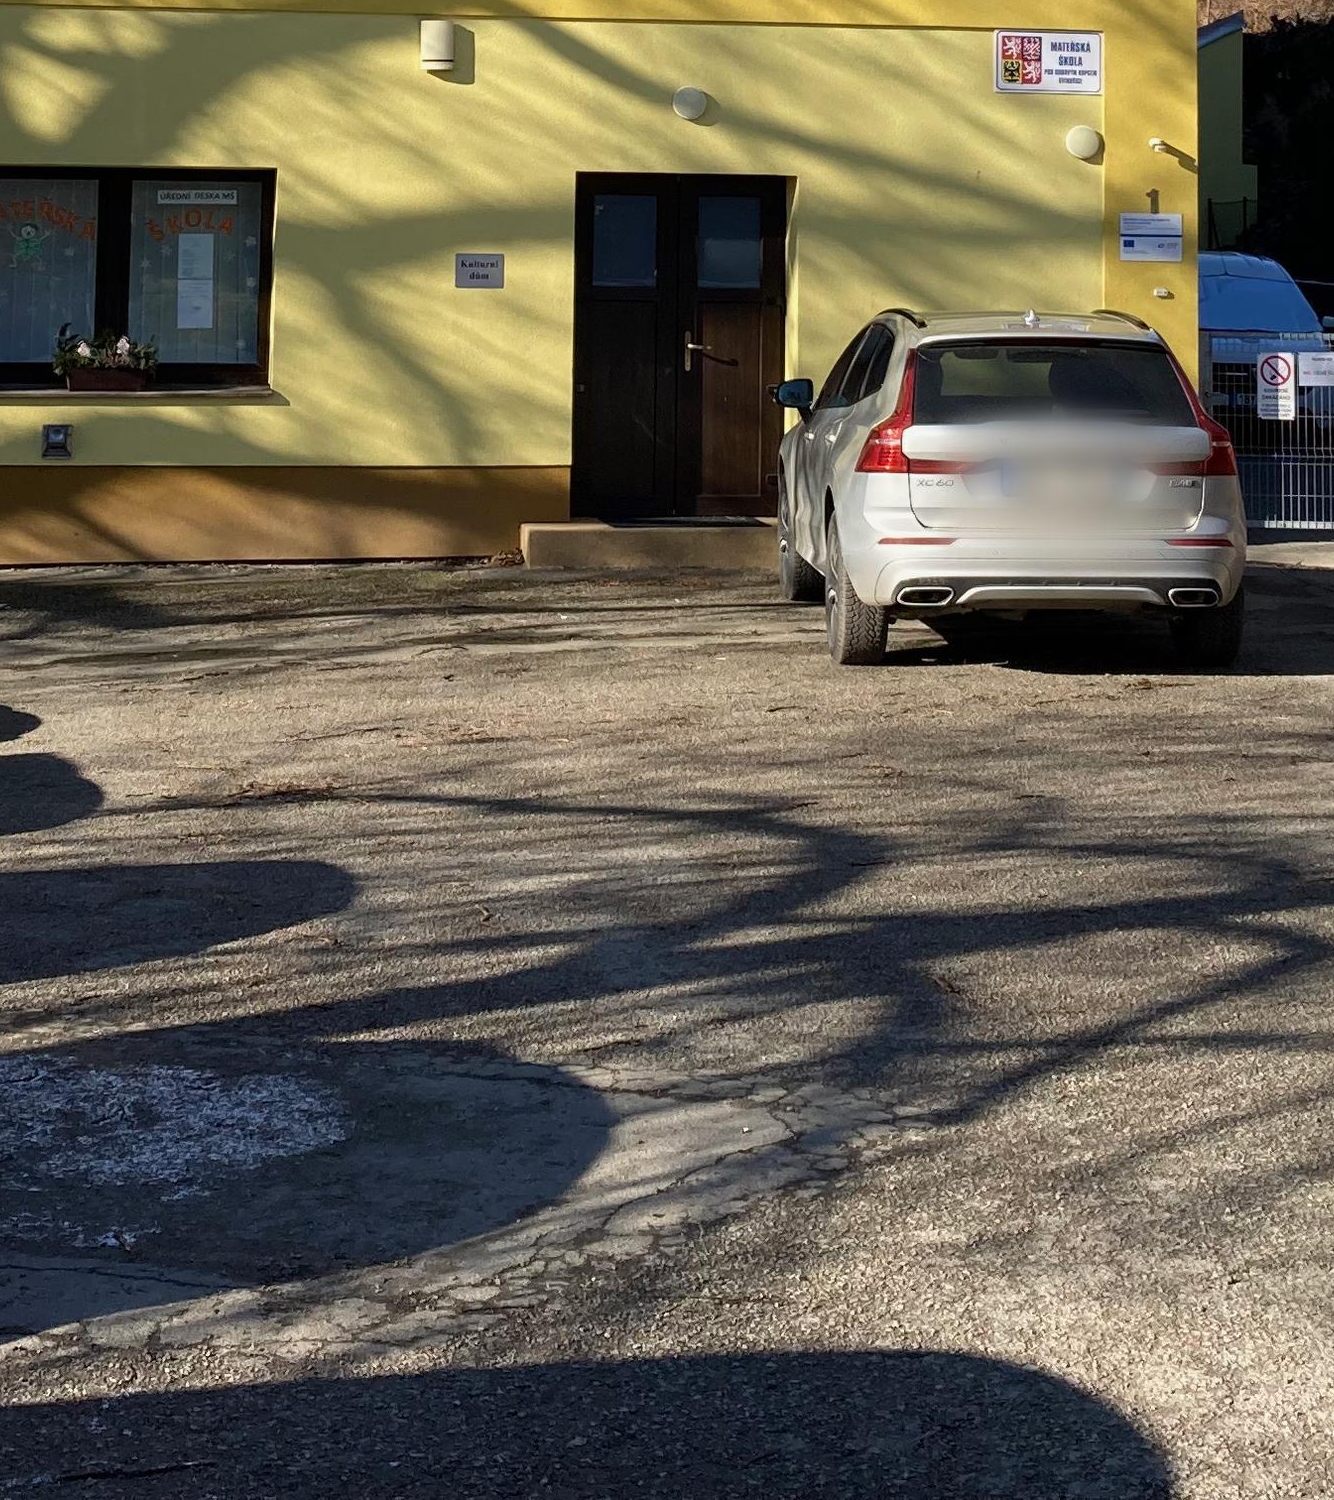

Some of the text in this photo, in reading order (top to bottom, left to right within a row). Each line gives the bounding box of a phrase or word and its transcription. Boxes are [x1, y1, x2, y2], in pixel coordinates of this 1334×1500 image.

[1050, 41, 1091, 53] MATEŘSKÁ
[1058, 55, 1083, 67] ŠKOLA
[159, 191, 191, 201] ÚŘEDNÍ
[194, 191, 221, 201] DESKA
[1146, 188, 1160, 214] 1
[144, 208, 235, 242] ŠKOLA
[460, 260, 500, 269] Kulturní
[469, 271, 489, 280] dům
